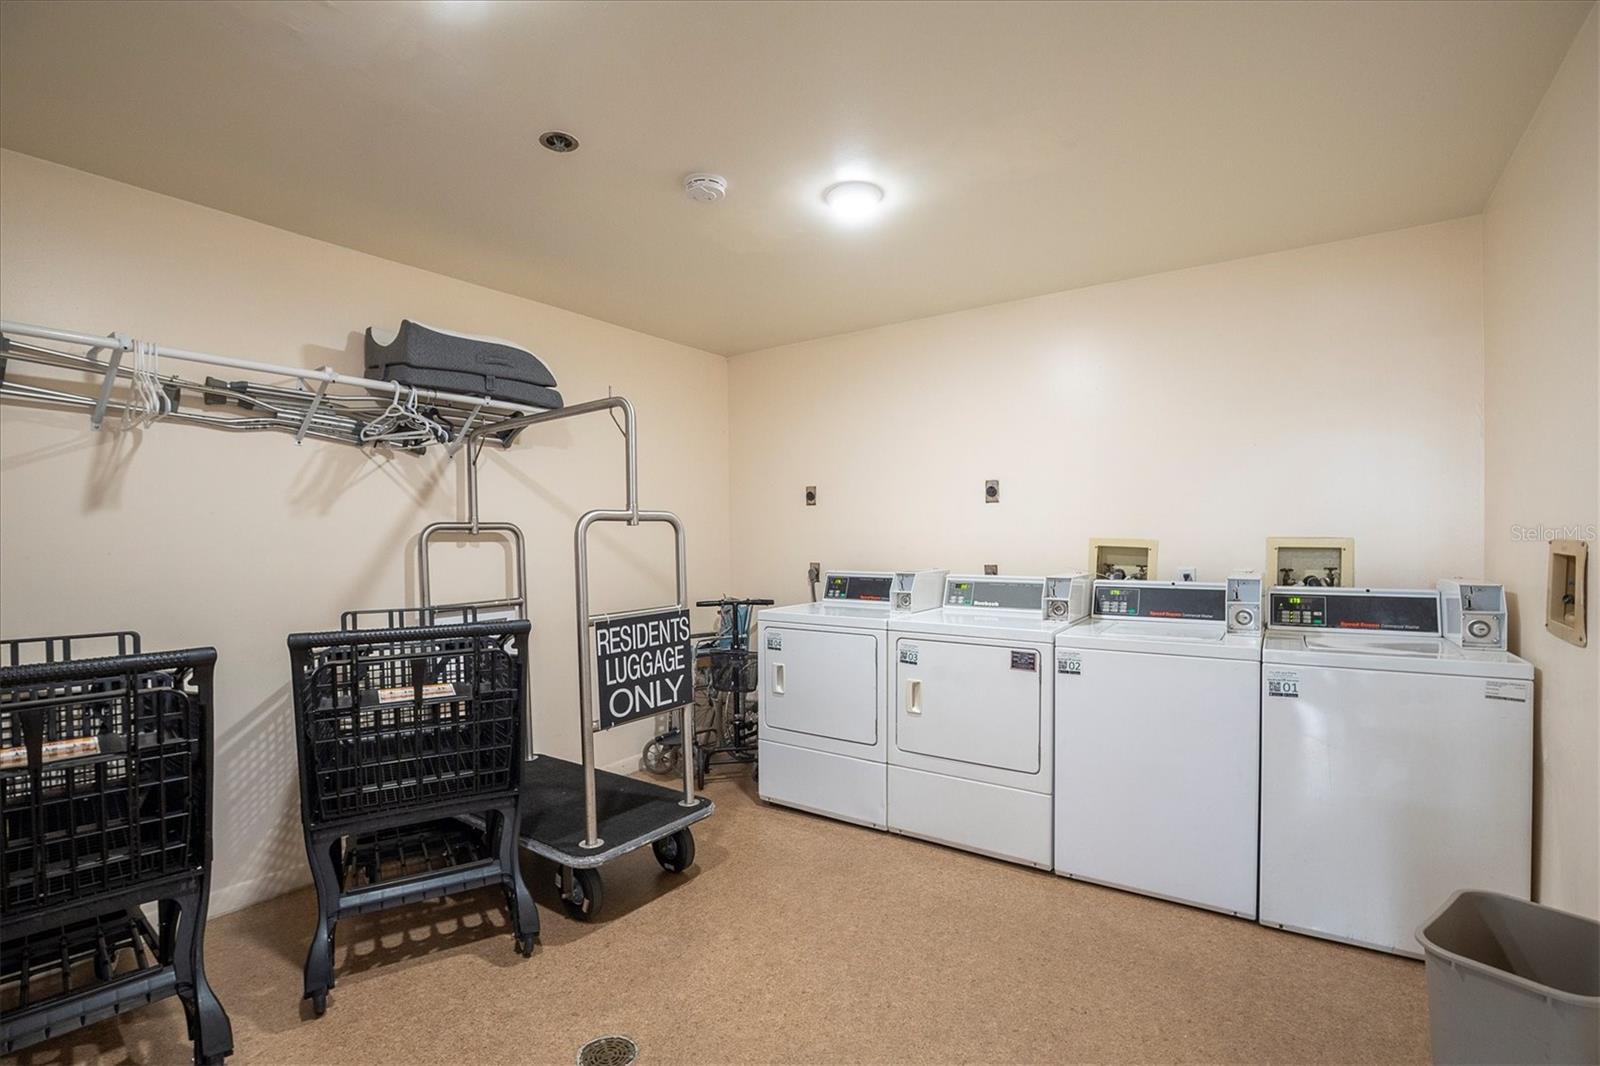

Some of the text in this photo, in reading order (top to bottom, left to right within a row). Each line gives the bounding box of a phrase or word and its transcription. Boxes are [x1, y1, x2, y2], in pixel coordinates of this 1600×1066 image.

[596, 616, 690, 656] RESIDENTS
[605, 645, 686, 686] LUGGAGE
[907, 652, 918, 662] 03
[1068, 661, 1081, 671] 02
[609, 674, 685, 718] ONLY
[1282, 681, 1298, 693] 01
